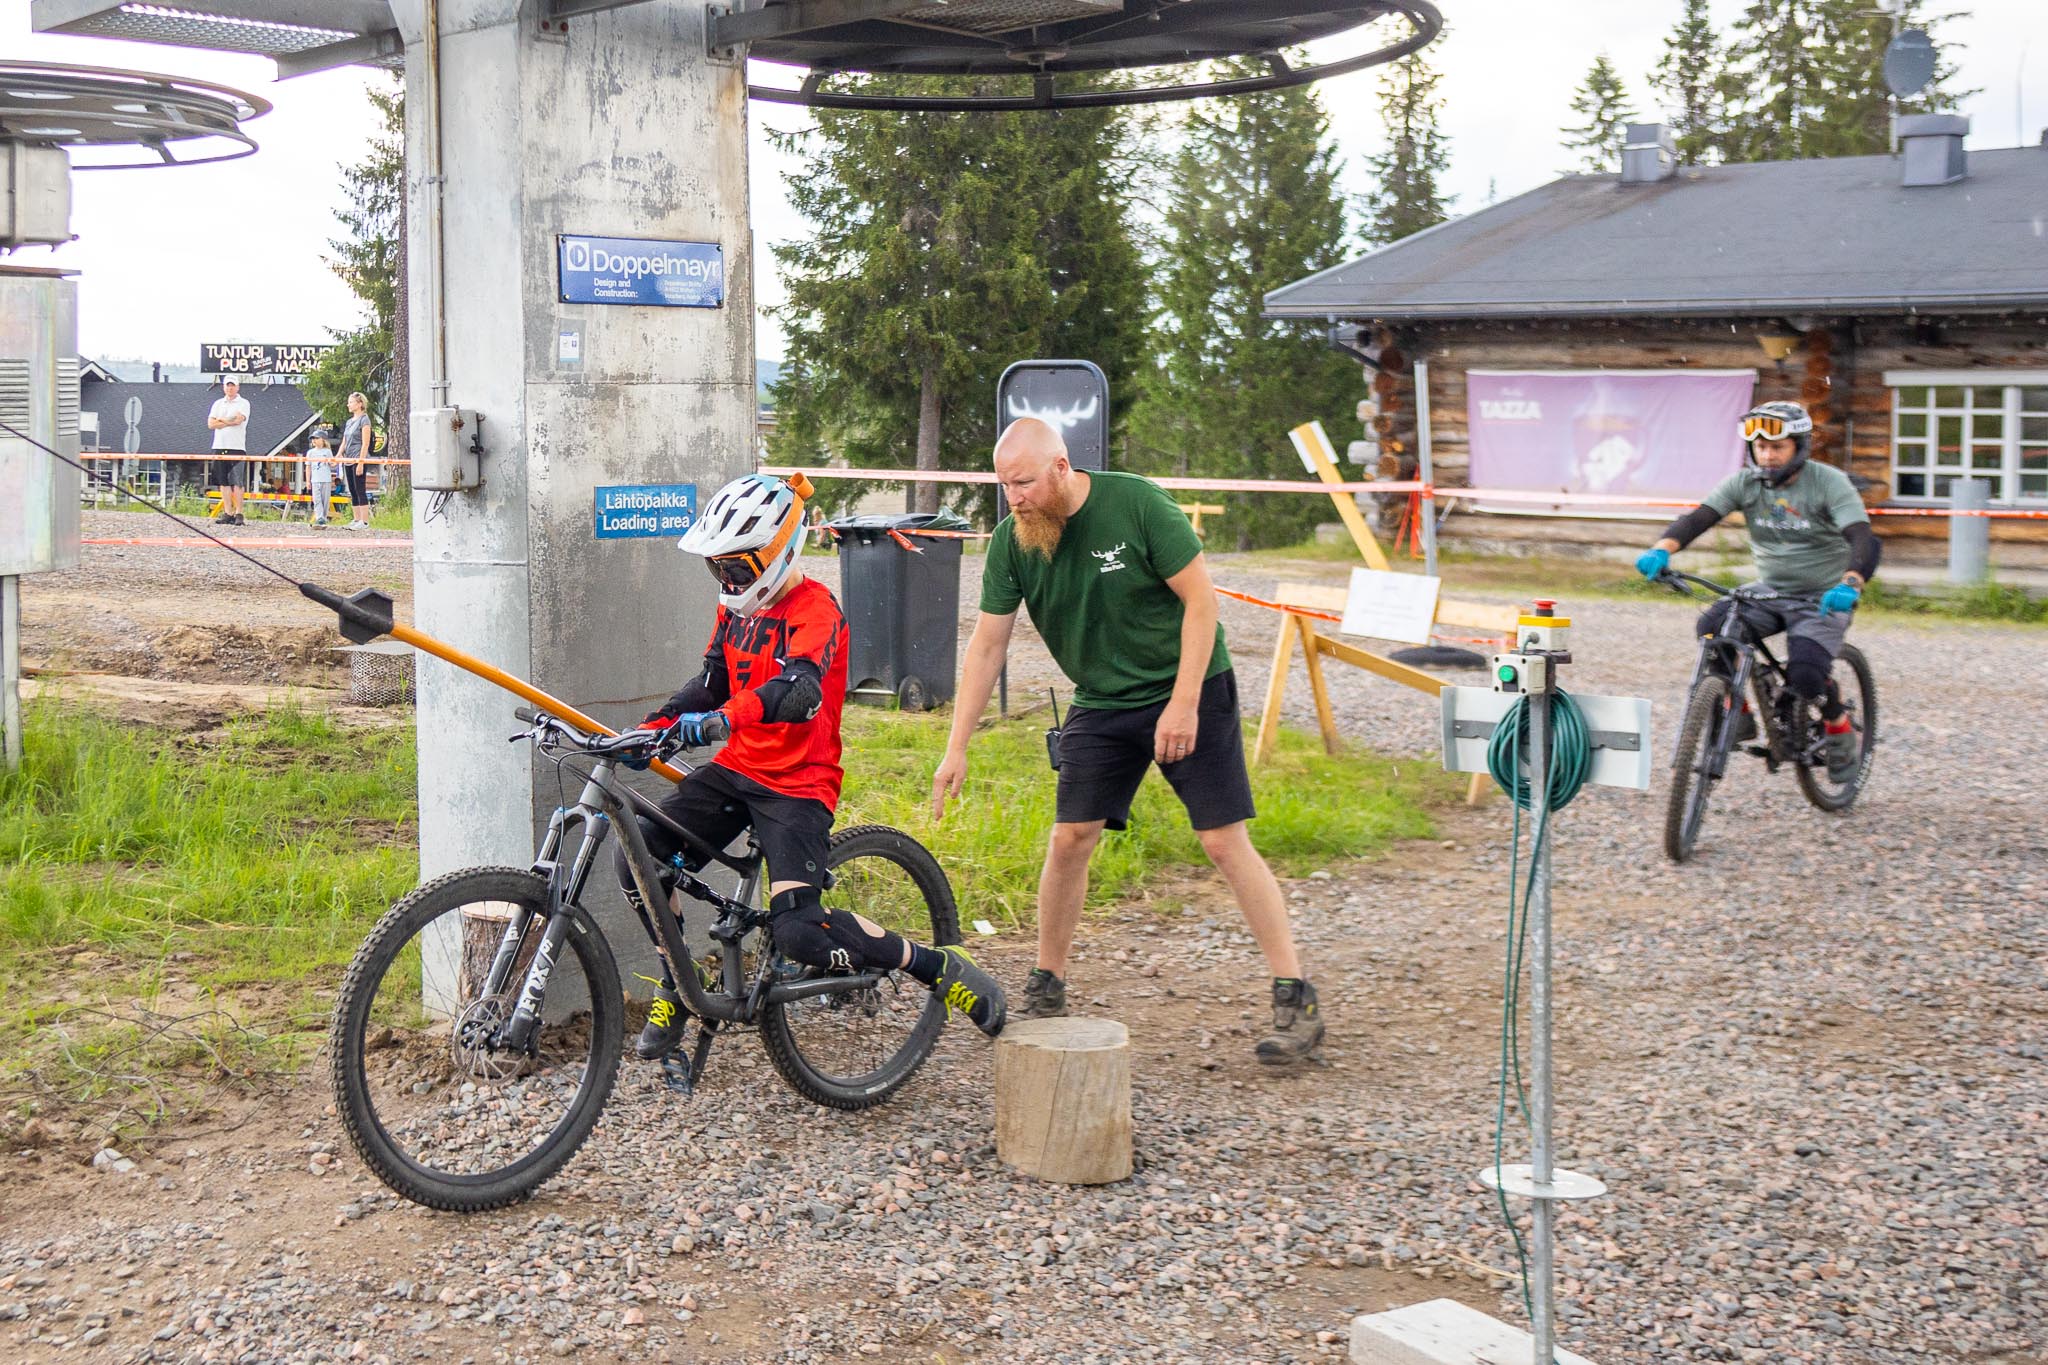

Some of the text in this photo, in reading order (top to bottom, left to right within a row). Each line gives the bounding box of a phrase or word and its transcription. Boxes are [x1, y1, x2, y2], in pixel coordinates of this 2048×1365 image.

[593, 249, 720, 281] Doppelmayr
[594, 277, 631, 288] Design and
[594, 288, 638, 298] Construction:
[206, 345, 264, 359] TUNTURI
[220, 359, 249, 372] PUB
[1478, 400, 1542, 420] TAZZA
[605, 492, 688, 512] Lähtöpaikka
[602, 514, 690, 532] Loading area
[517, 962, 551, 1014] FOX
